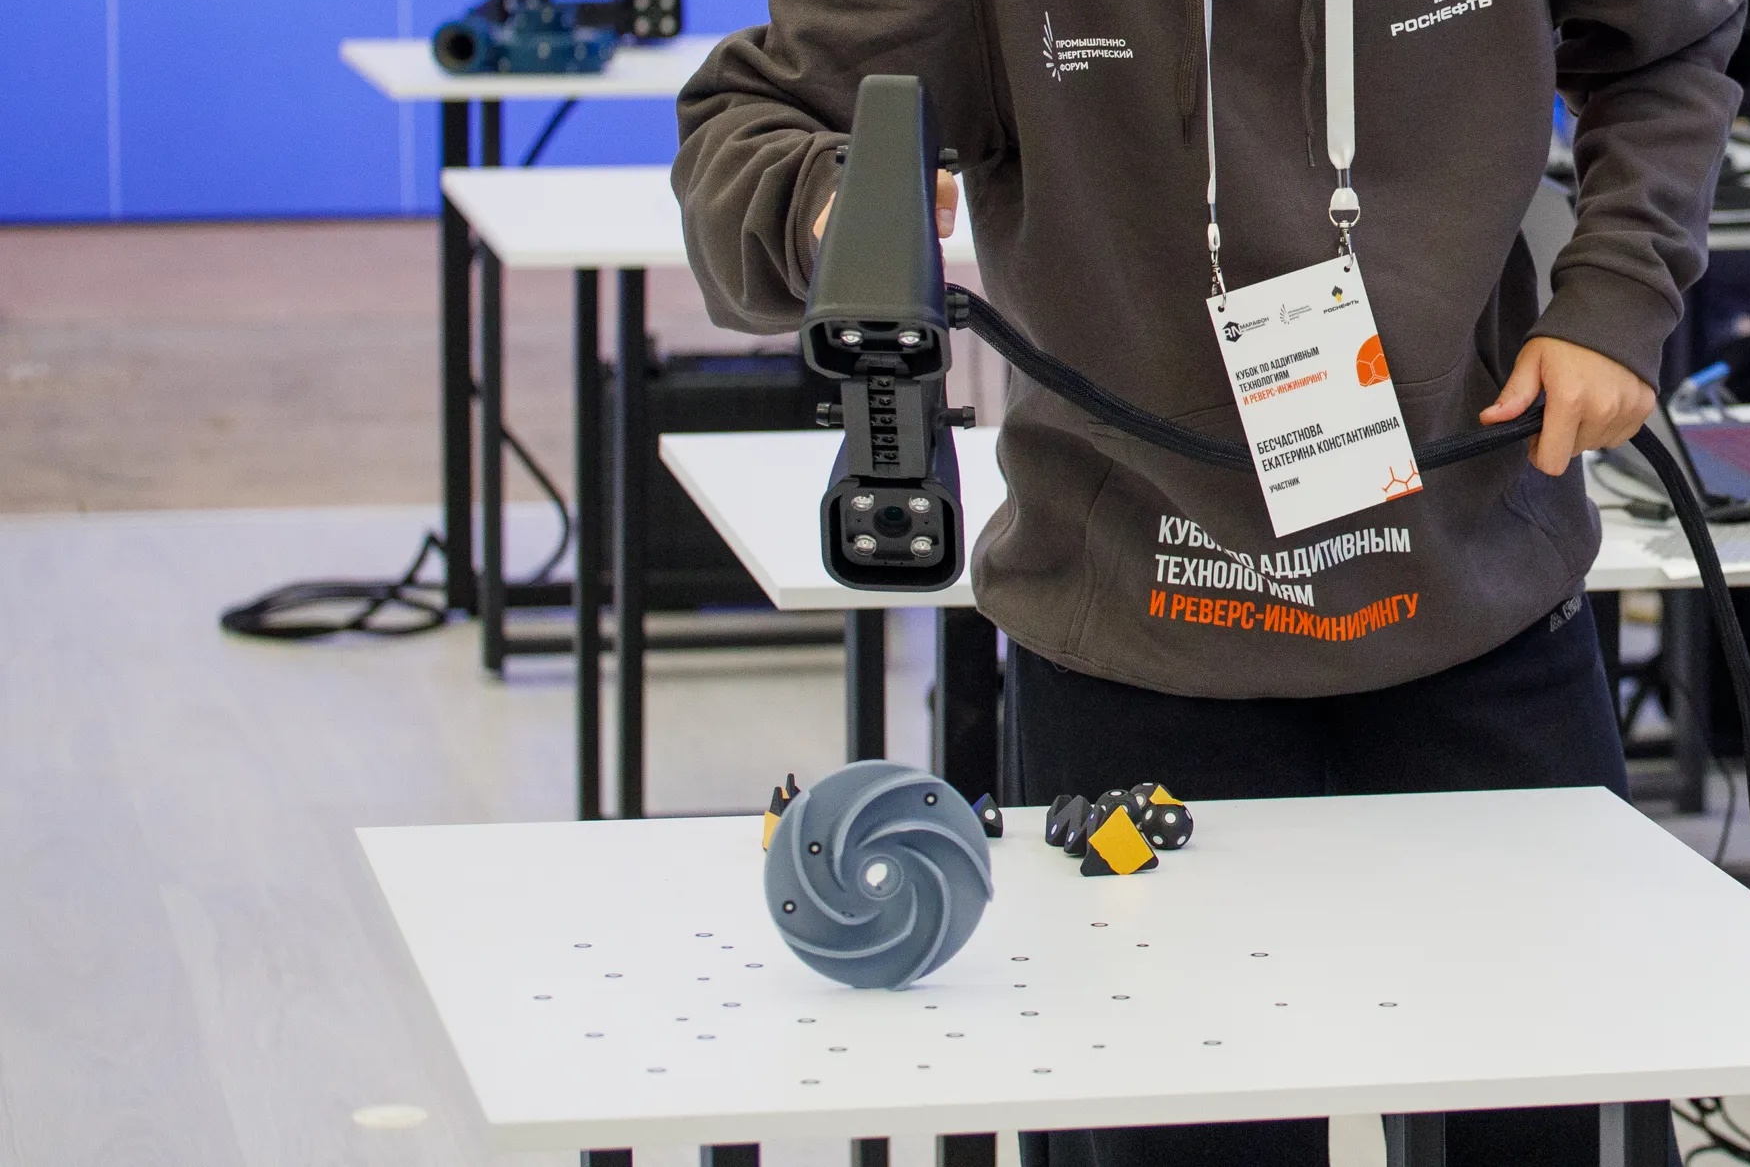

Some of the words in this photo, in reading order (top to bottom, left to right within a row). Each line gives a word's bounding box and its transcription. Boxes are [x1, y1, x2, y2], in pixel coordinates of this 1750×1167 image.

[1056, 38, 1126, 48] ПРОМЫШЛЕННО
[1058, 49, 1133, 60] ЭНЕРГЕТИЧЕСКИЙ
[1060, 61, 1089, 71] ФОРУМ
[1323, 300, 1359, 314] РОСНЕФТЬ
[1240, 317, 1269, 330] МАРАФОН
[1235, 366, 1259, 381] КУБОК
[1259, 362, 1269, 374] ПО
[1270, 346, 1320, 370] АДДИТИВНЫМ
[1238, 369, 1290, 393] ТЕХНОЛОГИЯМ
[1243, 396, 1249, 406] И
[1249, 370, 1328, 404] РЕВЕРС-ИНЖИНИРИНГУ
[1256, 423, 1323, 455] БЕСЧАСТНОВА
[1261, 444, 1316, 472] ЕКАТЕРИНА
[1316, 416, 1400, 454] КОНСТАНТИНОВНА
[1269, 476, 1300, 493] УЧАСТНИК
[1260, 527, 1411, 579] АДДИТИВНЫМ
[1154, 554, 1315, 607] ТЕХНОЛОГИЯМ
[1149, 589, 1167, 618] И
[1170, 592, 1419, 642] РЕВЕРС-ИНЖИНИРИНГУ
